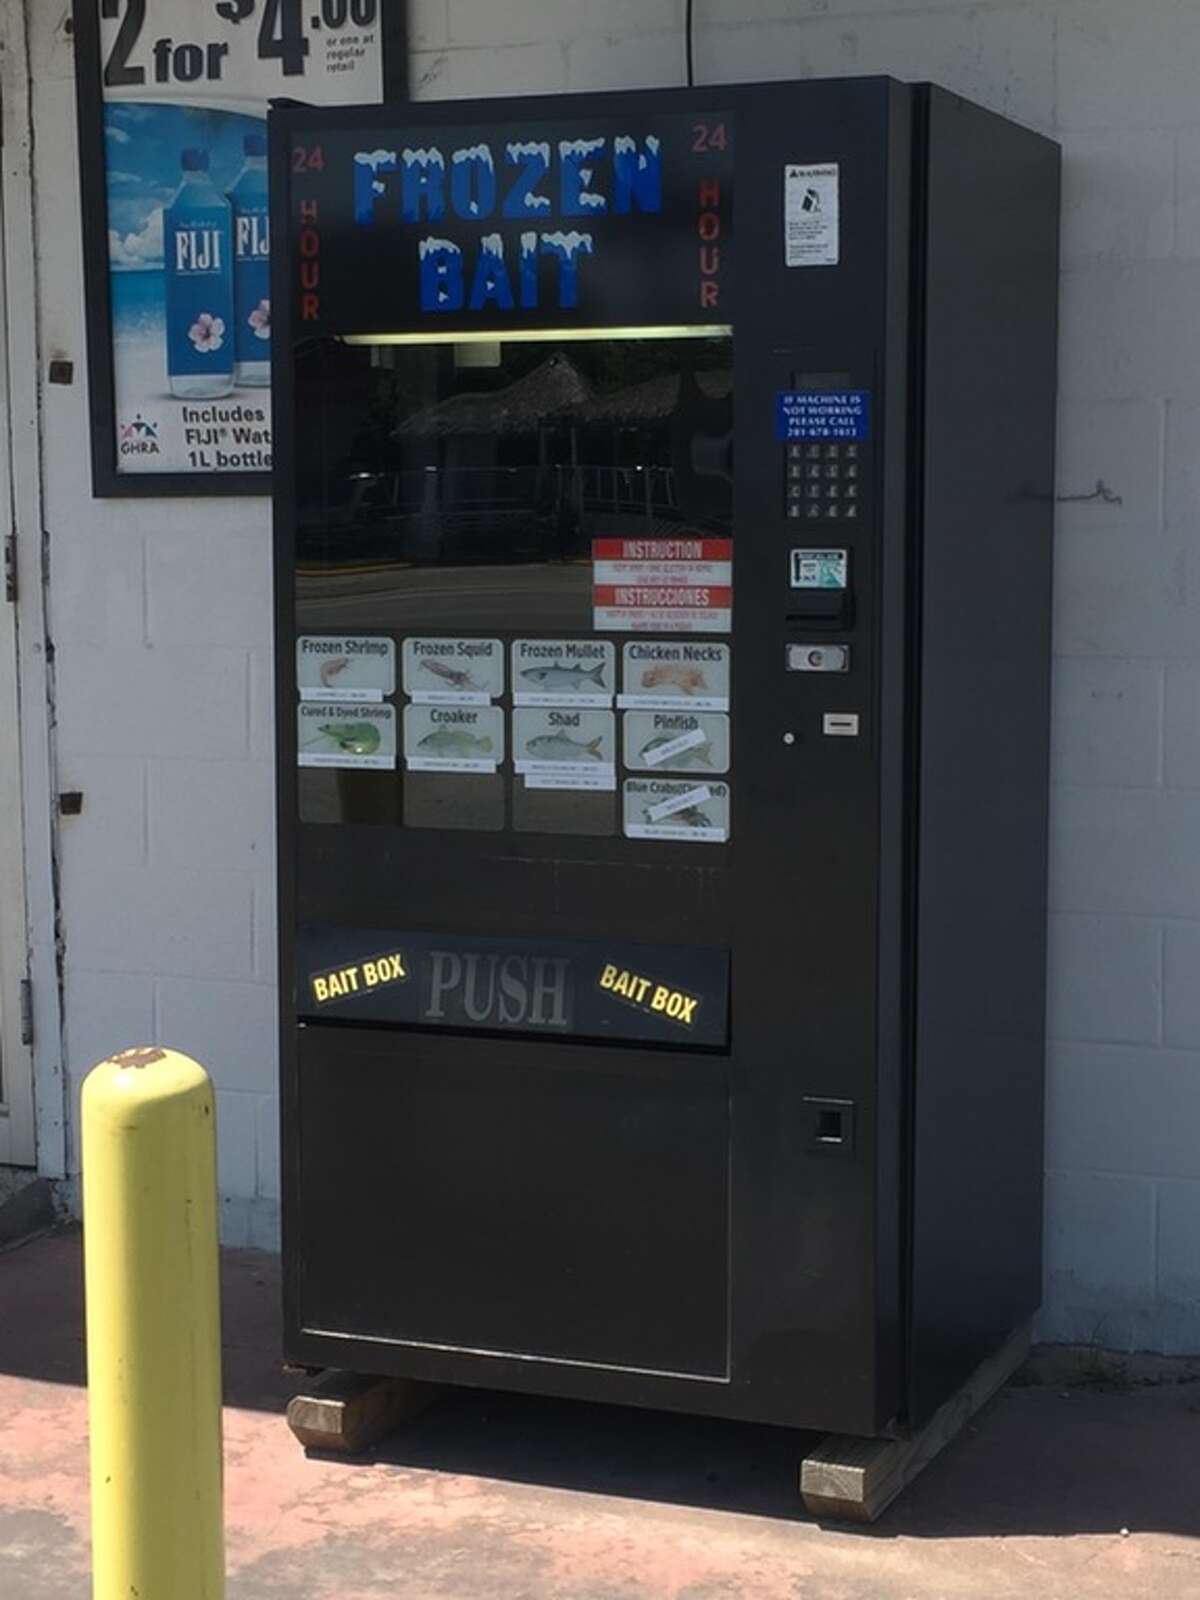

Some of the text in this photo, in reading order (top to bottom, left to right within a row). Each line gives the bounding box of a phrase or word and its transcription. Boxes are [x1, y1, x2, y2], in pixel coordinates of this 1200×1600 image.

[102, 0, 145, 87] 2
[152, 38, 228, 83] for
[326, 46, 366, 60] regular
[326, 60, 355, 73] retail
[692, 124, 727, 153] 24
[292, 146, 324, 173] 24
[353, 135, 663, 225] FROZEN
[176, 230, 222, 270] FIJI
[418, 231, 594, 313] BAIT
[796, 395, 848, 404] MACHINE
[849, 395, 862, 404] IS
[182, 406, 265, 423] Includes
[782, 406, 863, 416] NOT WORKING
[788, 416, 856, 426] PLEASE CALL
[120, 441, 160, 455] GHRA
[188, 451, 211, 468] 1L
[622, 540, 702, 559] INSTRUCTION
[614, 587, 710, 606] INSTRUCCIONES
[302, 639, 389, 657] Frozen Shrimp
[413, 641, 493, 659] Frozen Squid
[520, 643, 605, 660] Frozen Mullet
[628, 645, 722, 663] Chicken Necks
[359, 707, 392, 720] Shrimp
[429, 708, 478, 724] Croaker
[547, 711, 580, 728] Shad
[653, 714, 698, 731] Pinfish
[626, 780, 648, 793] Blue
[313, 953, 406, 1003] BAIT BOX
[424, 950, 570, 1027] PUSH
[600, 963, 699, 1024] BAIT BOX
